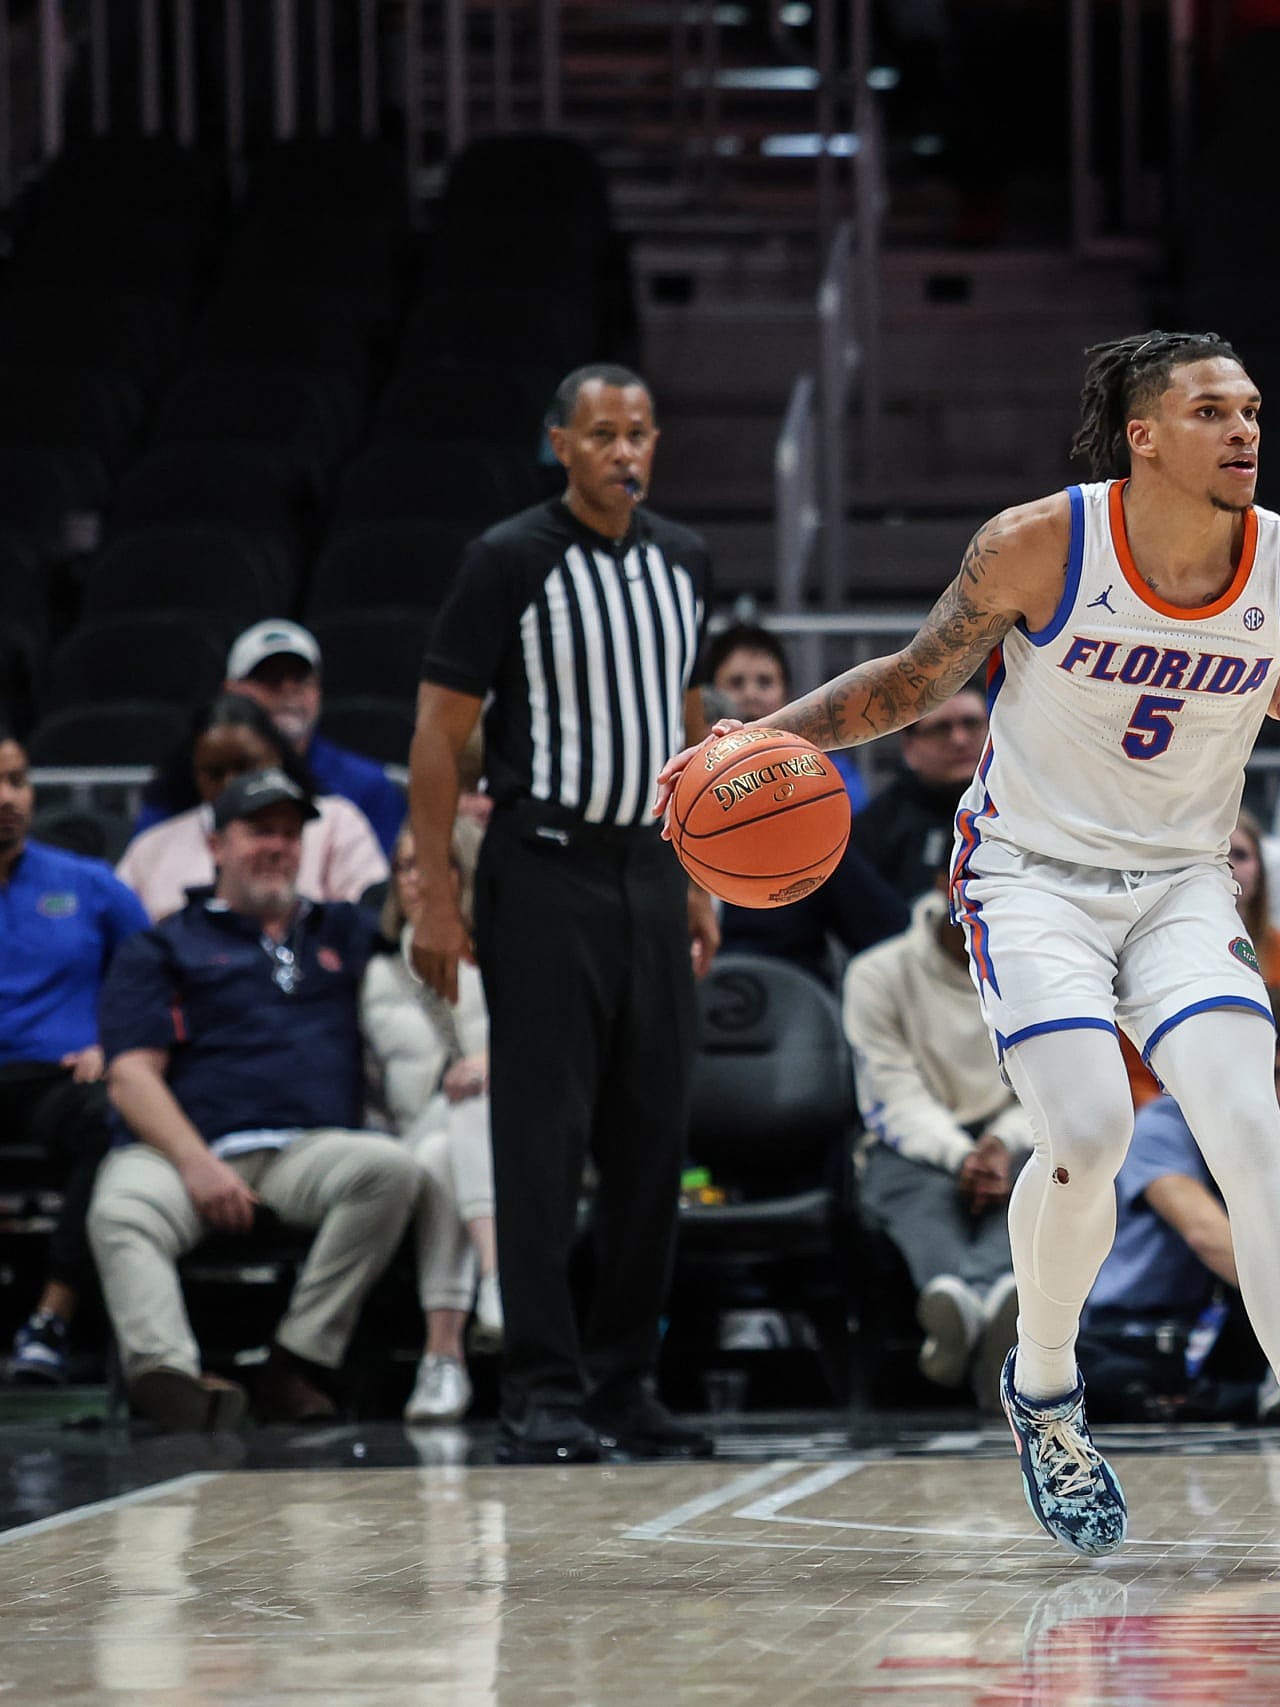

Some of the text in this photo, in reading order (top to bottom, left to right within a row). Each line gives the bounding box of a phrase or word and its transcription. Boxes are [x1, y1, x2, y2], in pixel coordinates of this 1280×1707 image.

[1244, 608, 1264, 630] SEC
[1056, 635, 1274, 696] FLORIDA
[704, 729, 786, 771] EGACY
[1121, 694, 1186, 760] 5
[713, 754, 827, 812] SPALDING
